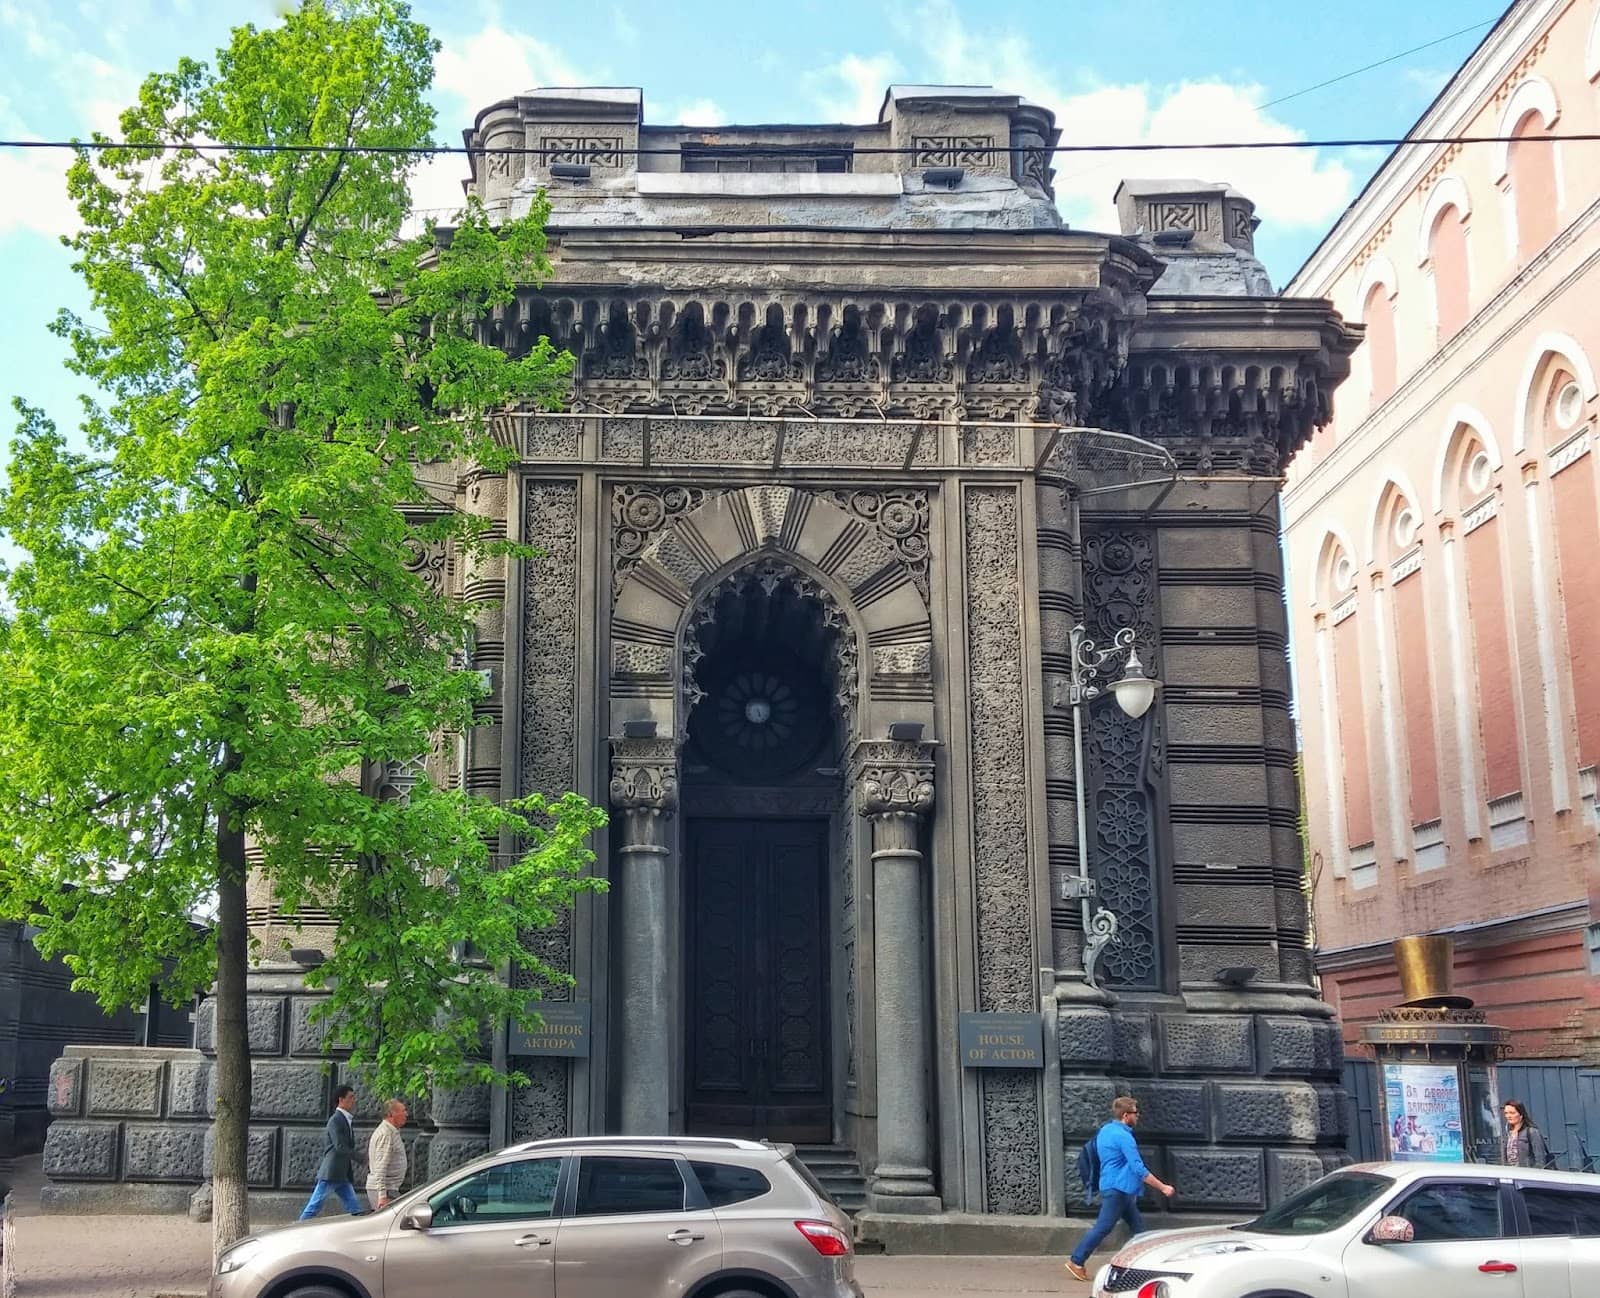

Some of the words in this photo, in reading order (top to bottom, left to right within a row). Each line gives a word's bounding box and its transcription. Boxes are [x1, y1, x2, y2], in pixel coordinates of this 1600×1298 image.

[517, 1023, 583, 1036] БДИНОК
[523, 1038, 577, 1049] АКТОРА
[978, 1034, 1025, 1046] HOUSE
[969, 1048, 986, 1060] OF
[992, 1048, 1036, 1060] ACTOR
